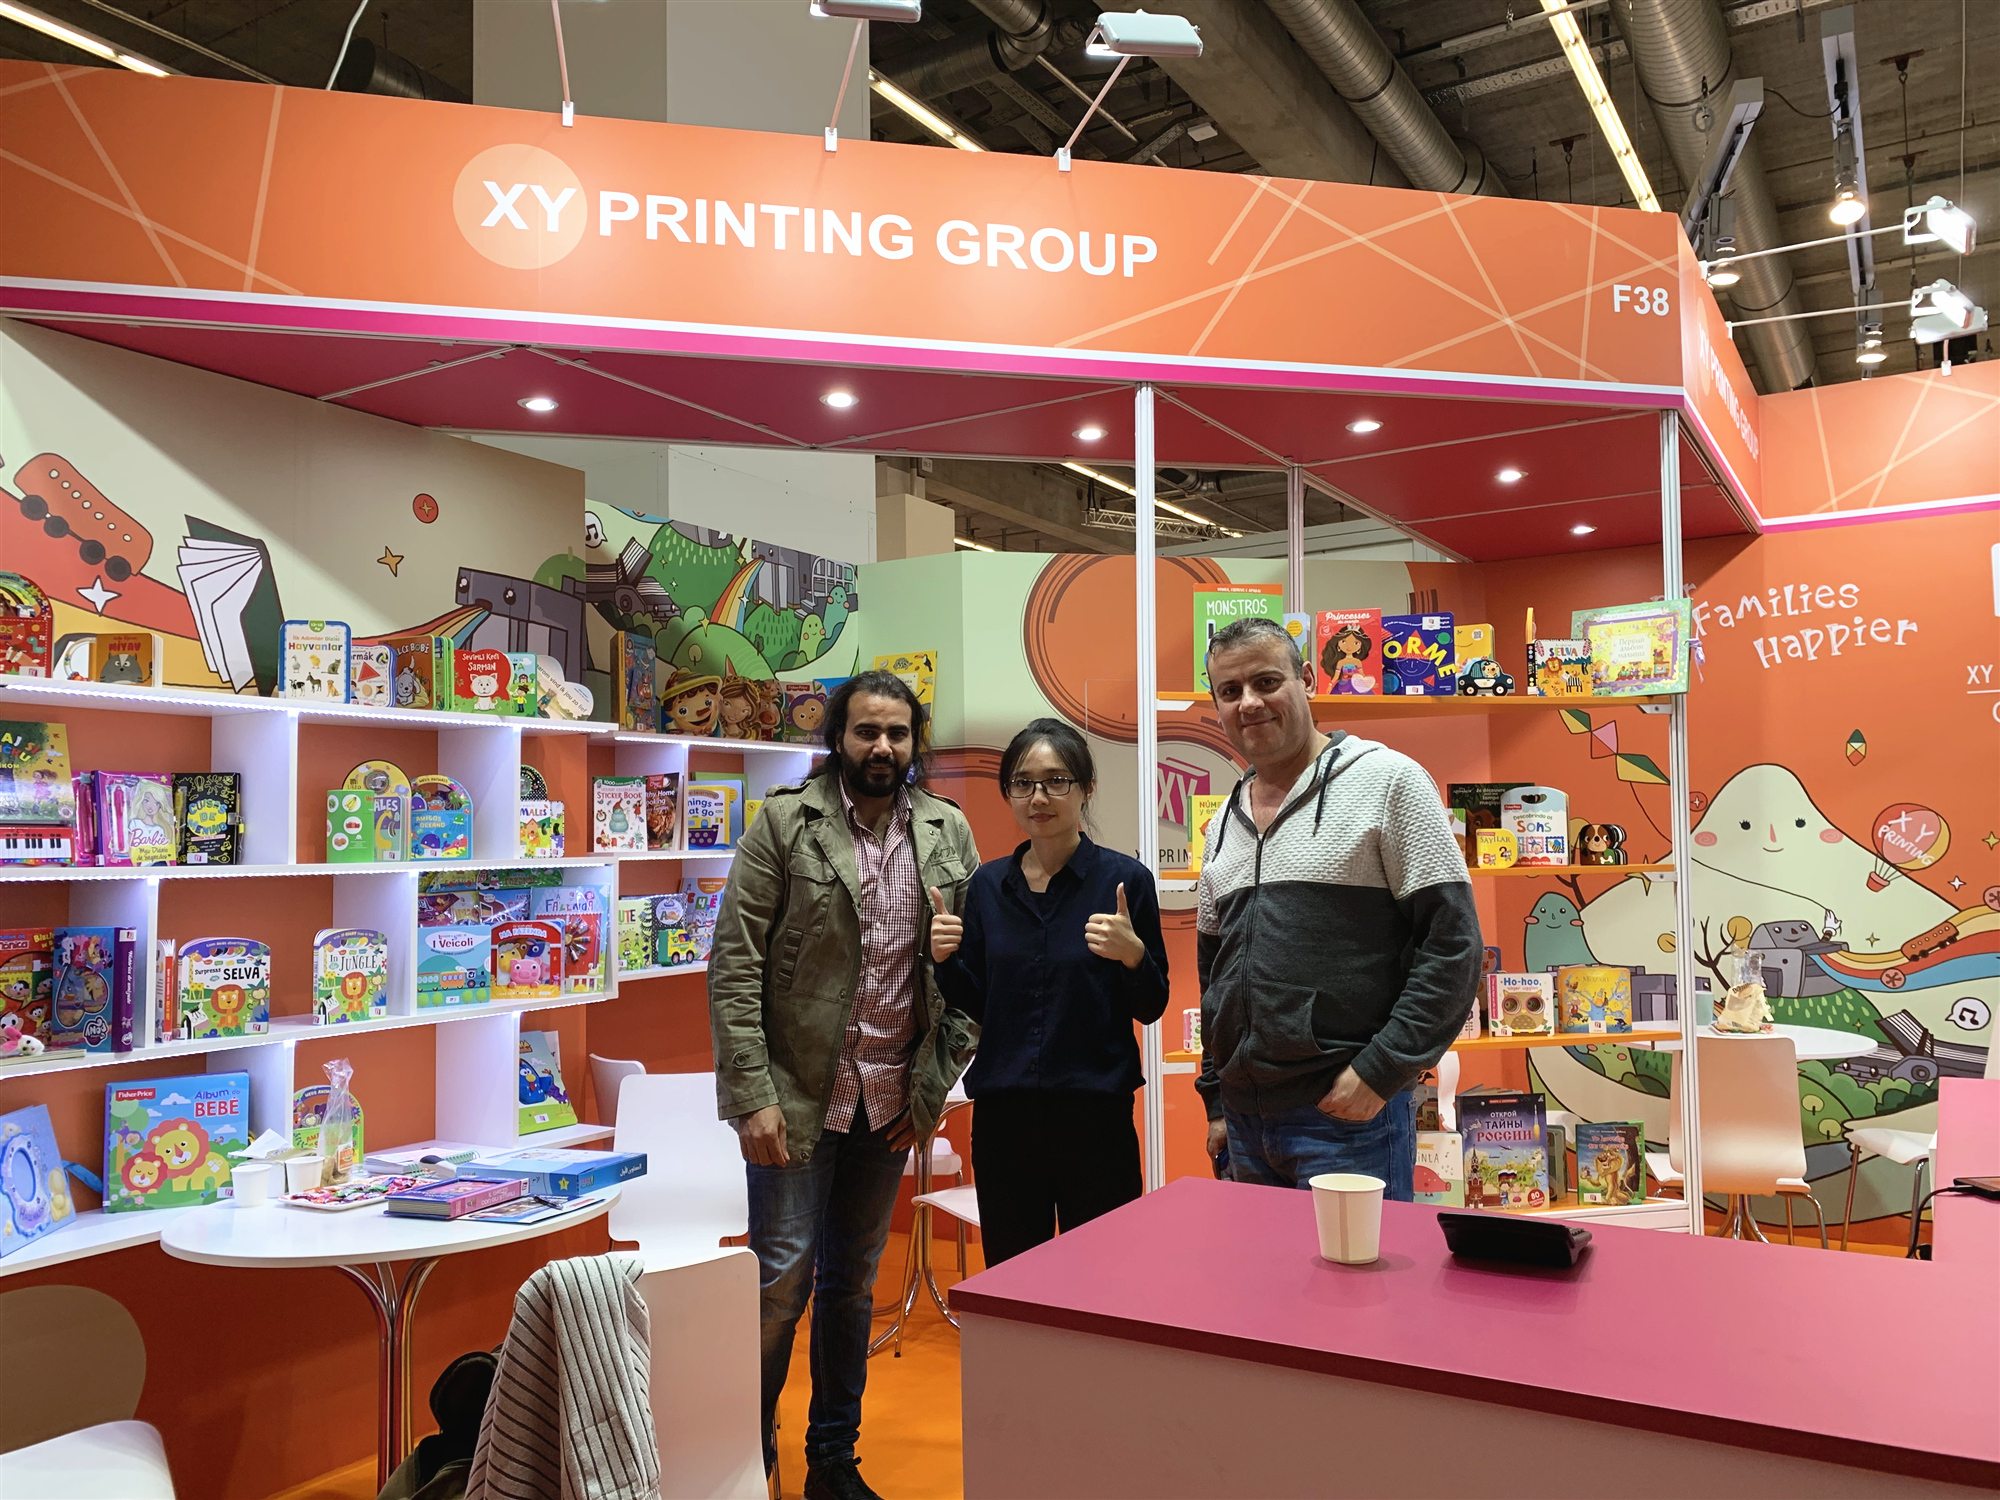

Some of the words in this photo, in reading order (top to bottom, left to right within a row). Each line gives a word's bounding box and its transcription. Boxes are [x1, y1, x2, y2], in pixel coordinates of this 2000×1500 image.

[481, 180, 577, 233] XY
[599, 189, 914, 260] PRINTING
[936, 219, 1158, 278] GROUP
[1613, 284, 1670, 316] F38
[1206, 598, 1268, 616] MONSTROS
[1692, 583, 1860, 637] Families
[1325, 611, 1371, 621] Princesses
[288, 642, 343, 652] Hayvanlar
[1618, 637, 1646, 647] Первый
[1753, 616, 1918, 669] Happier
[1549, 647, 1579, 657] SELVA
[1967, 664, 1994, 685] XY
[657, 789, 675, 797] Home
[646, 798, 666, 806] ooking
[200, 811, 217, 822] DE
[520, 807, 547, 817] MALES
[701, 808, 714, 817] go
[1512, 813, 1545, 821] Descobrindo
[1516, 820, 1552, 833] Sons
[131, 828, 169, 848] Barbie
[1878, 825, 1935, 866] PRINTING
[1159, 848, 1189, 863] PRIN
[1482, 853, 1491, 865] 5
[512, 927, 548, 937] FAZENDA
[439, 937, 474, 948] Veicoli
[339, 954, 378, 971] JUNGLE
[194, 967, 221, 976] Surpresas
[223, 966, 260, 981] SELVA
[1503, 977, 1542, 987] Ho-hoo,
[118, 1089, 153, 1099] Fisher-Price
[1490, 1109, 1517, 1119] ОТКРОЙ
[1485, 1119, 1523, 1130] ТАЙНЫ
[1477, 1130, 1532, 1142] РОССИИ
[1530, 1191, 1540, 1200] 80
